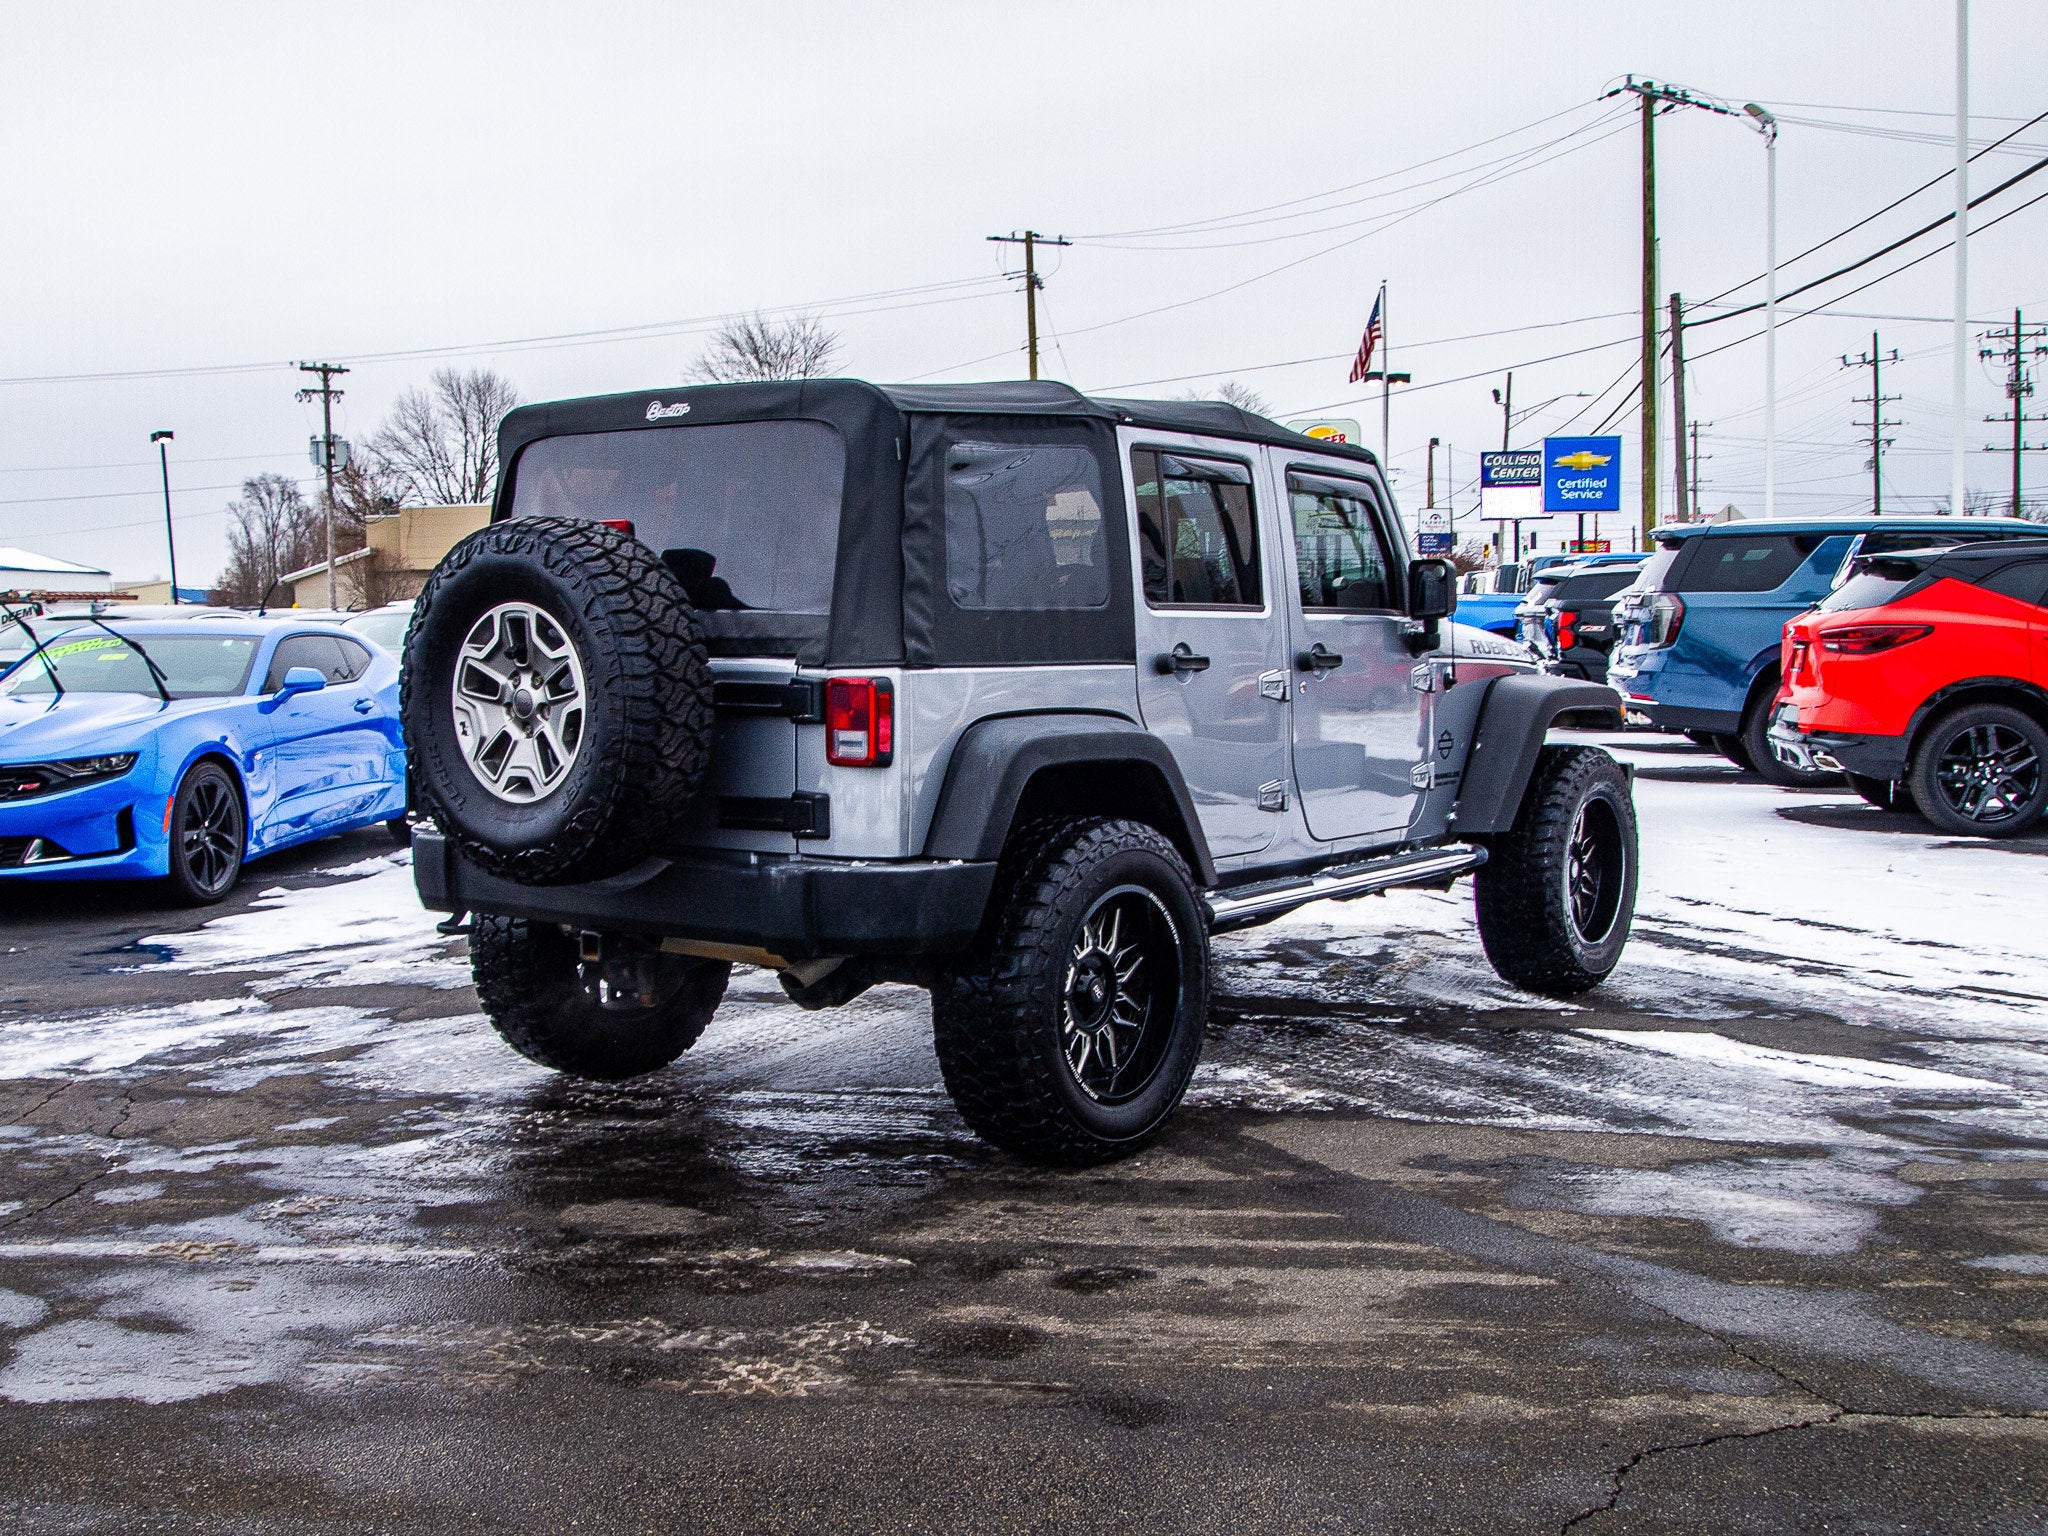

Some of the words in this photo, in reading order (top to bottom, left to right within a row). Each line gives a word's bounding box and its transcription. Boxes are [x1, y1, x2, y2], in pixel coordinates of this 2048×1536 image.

[1484, 454, 1541, 466] COLLISIO
[1490, 467, 1540, 478] CENTER
[1557, 477, 1608, 489] Certified
[1561, 489, 1603, 499] Service
